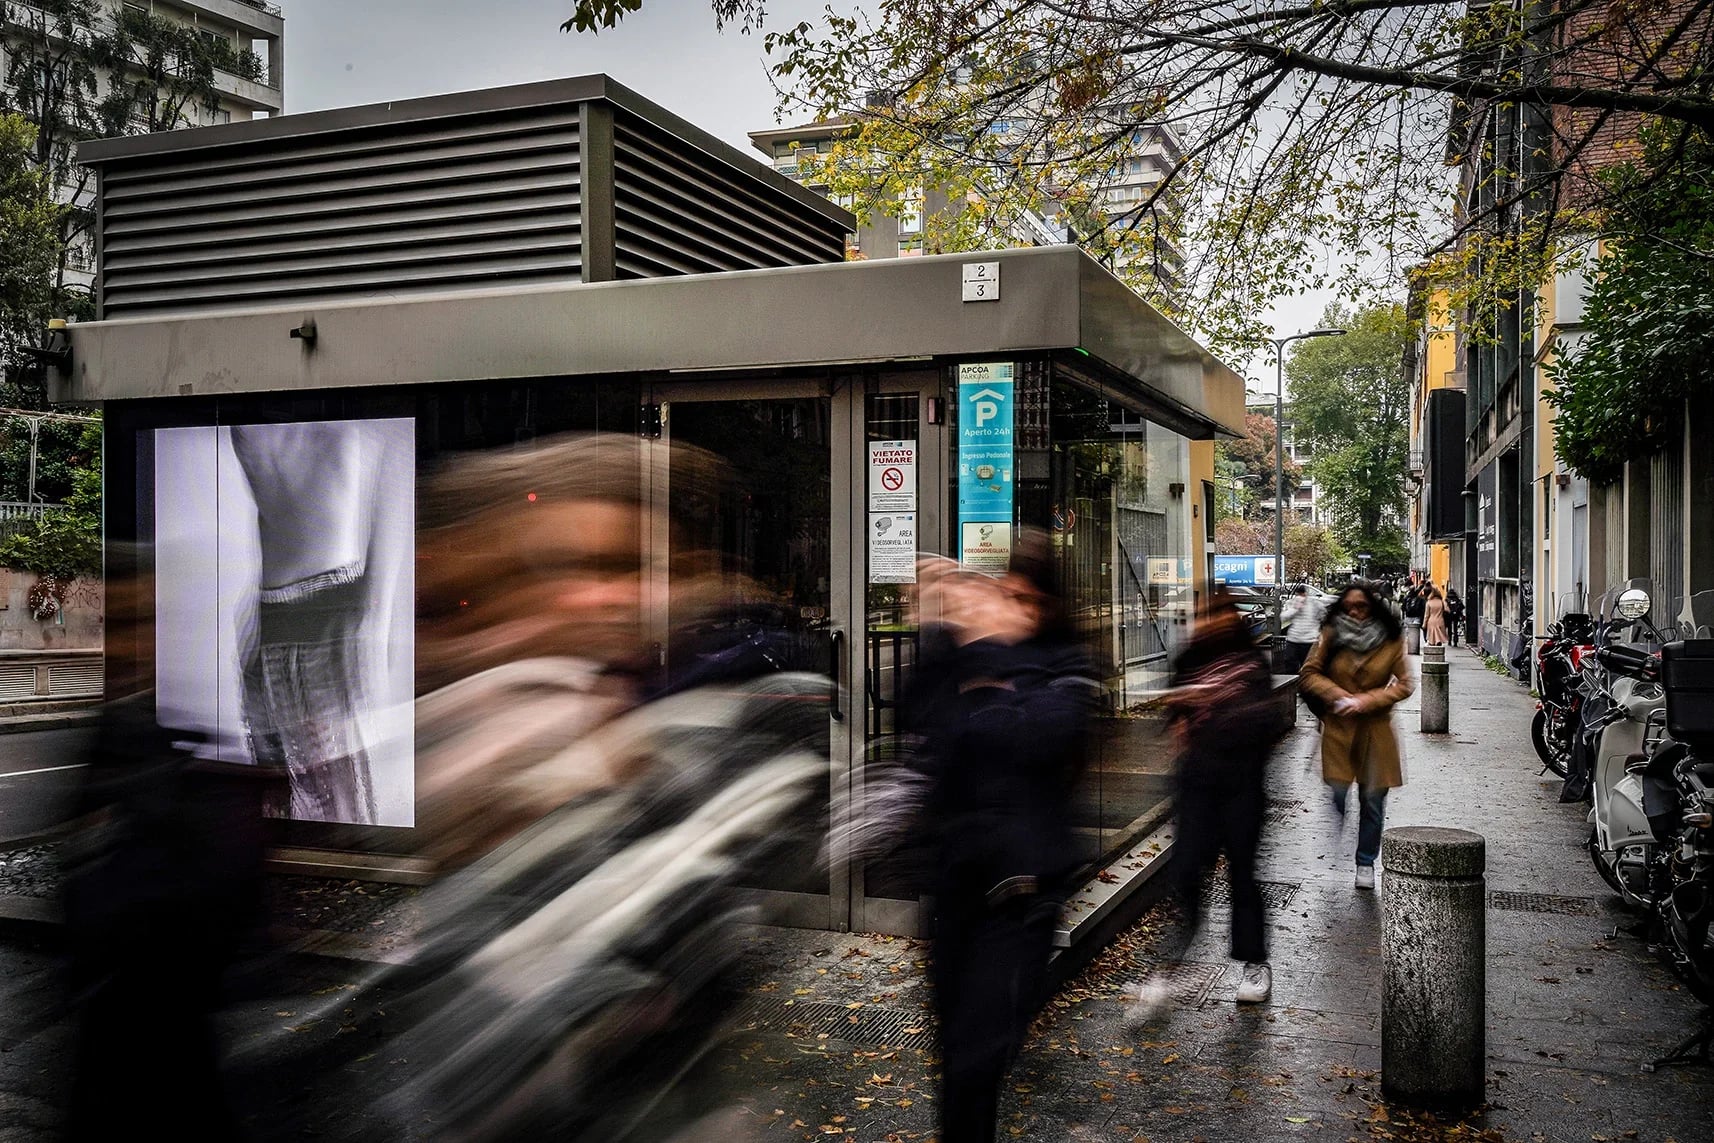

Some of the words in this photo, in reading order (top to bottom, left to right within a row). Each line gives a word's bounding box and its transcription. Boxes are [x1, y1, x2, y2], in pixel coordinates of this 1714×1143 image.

[978, 265, 985, 277] 2
[977, 285, 985, 297] 3
[976, 401, 998, 427] P
[965, 429, 992, 437] Aperto
